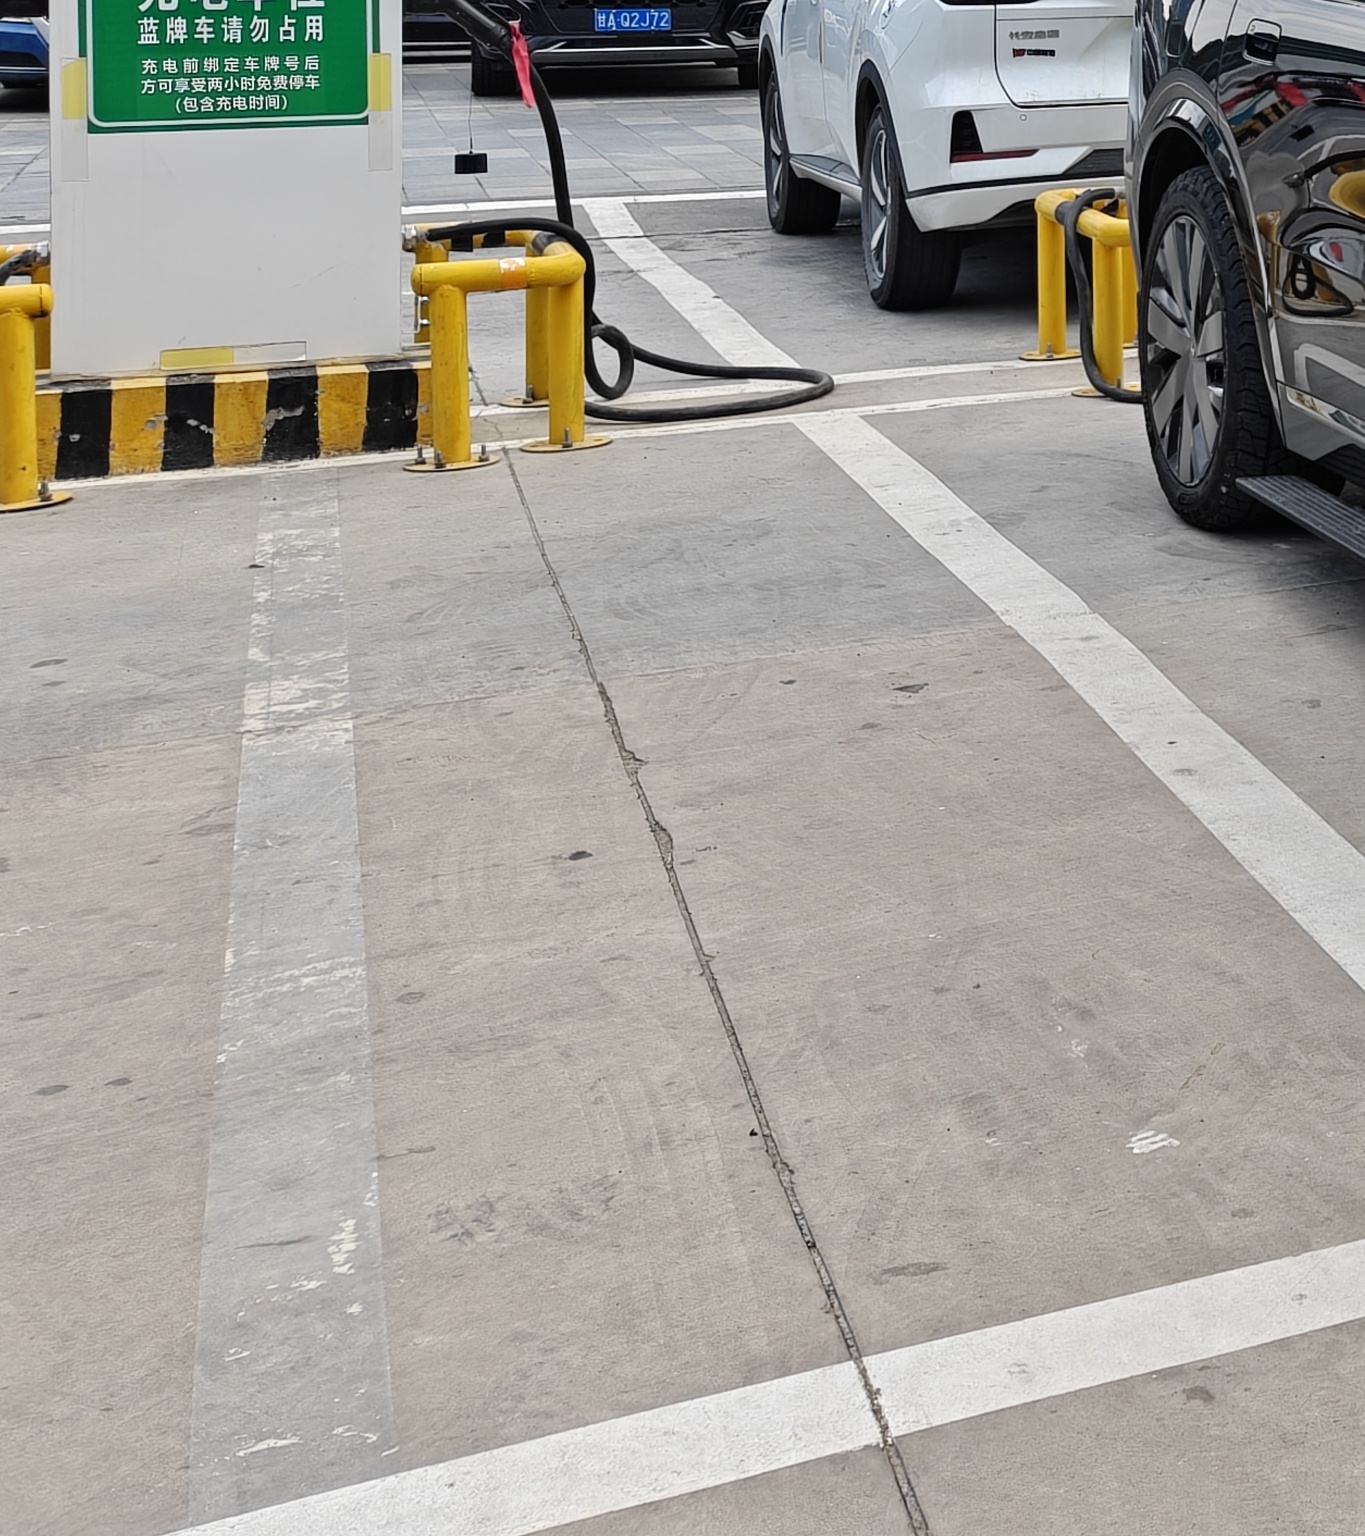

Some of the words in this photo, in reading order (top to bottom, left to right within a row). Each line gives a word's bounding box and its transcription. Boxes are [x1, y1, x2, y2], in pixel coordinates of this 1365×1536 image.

[137, 14, 324, 45] 蓝牌车请勿占用
[141, 54, 320, 75] 充电前绑定车牌号后
[141, 74, 321, 95] 方可享受两小时免费停车
[175, 94, 288, 114] (包含充电时间)
